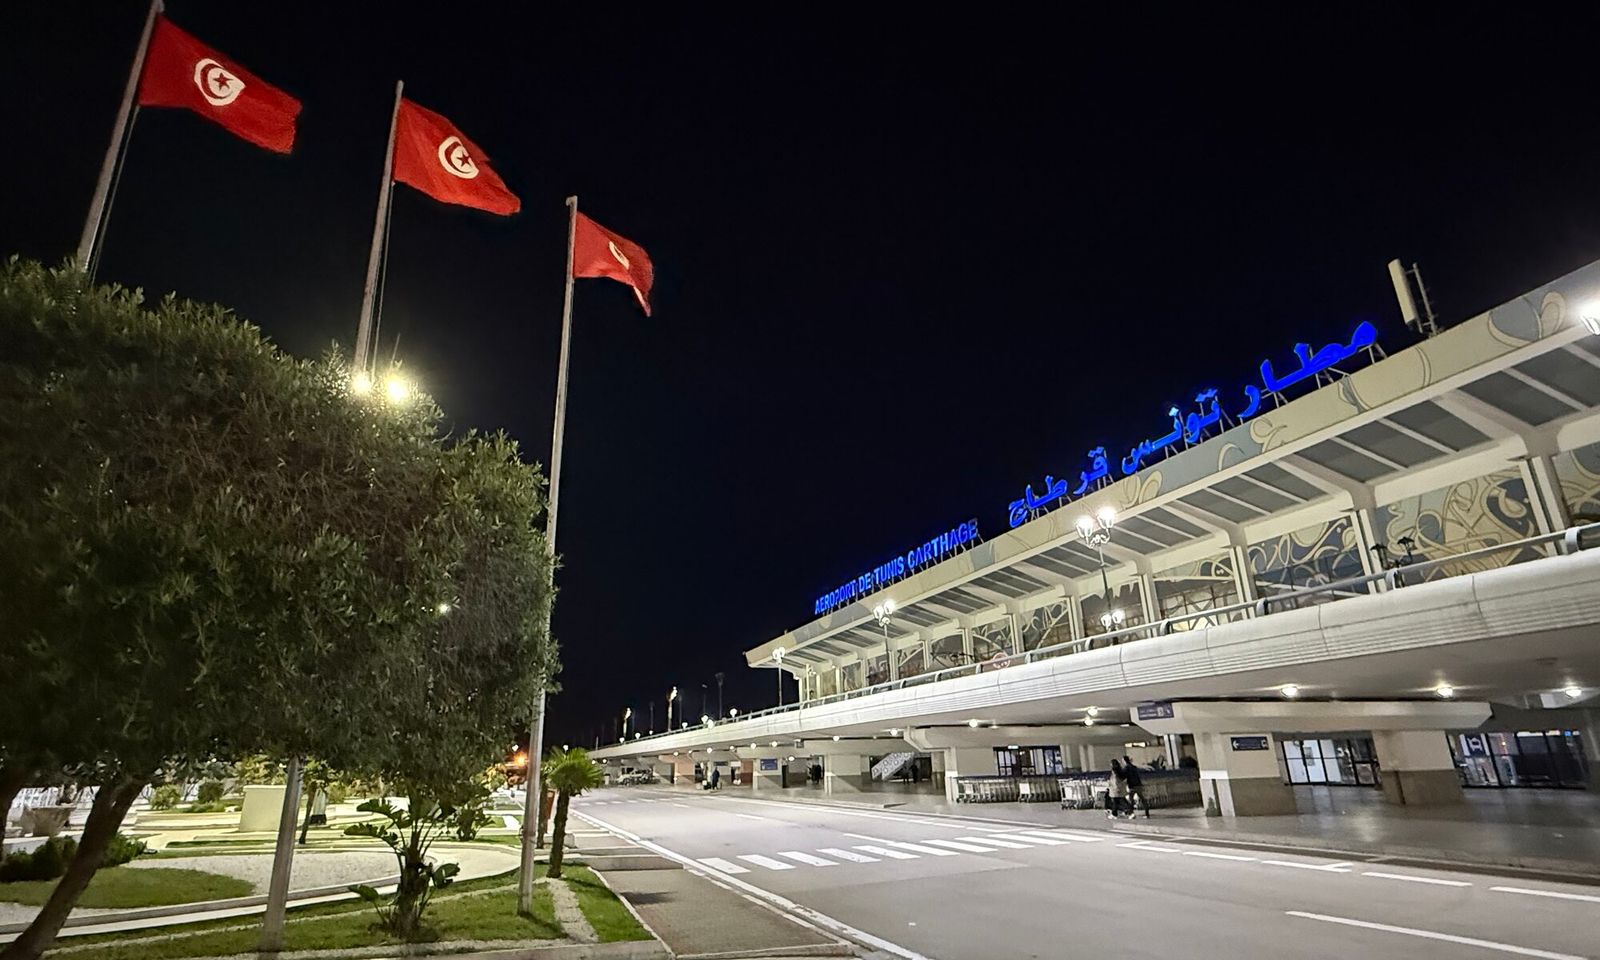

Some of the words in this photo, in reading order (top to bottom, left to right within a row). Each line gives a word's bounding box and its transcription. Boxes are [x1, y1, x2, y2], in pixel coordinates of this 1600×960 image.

[1238, 320, 1377, 420] مطار
[1121, 387, 1222, 475] تونس
[1007, 446, 1109, 529] قرطاج
[814, 579, 857, 615] AEROPORT
[858, 571, 872, 593] DE
[873, 556, 905, 585] TUNIS
[907, 518, 978, 569] CARTHAGE
